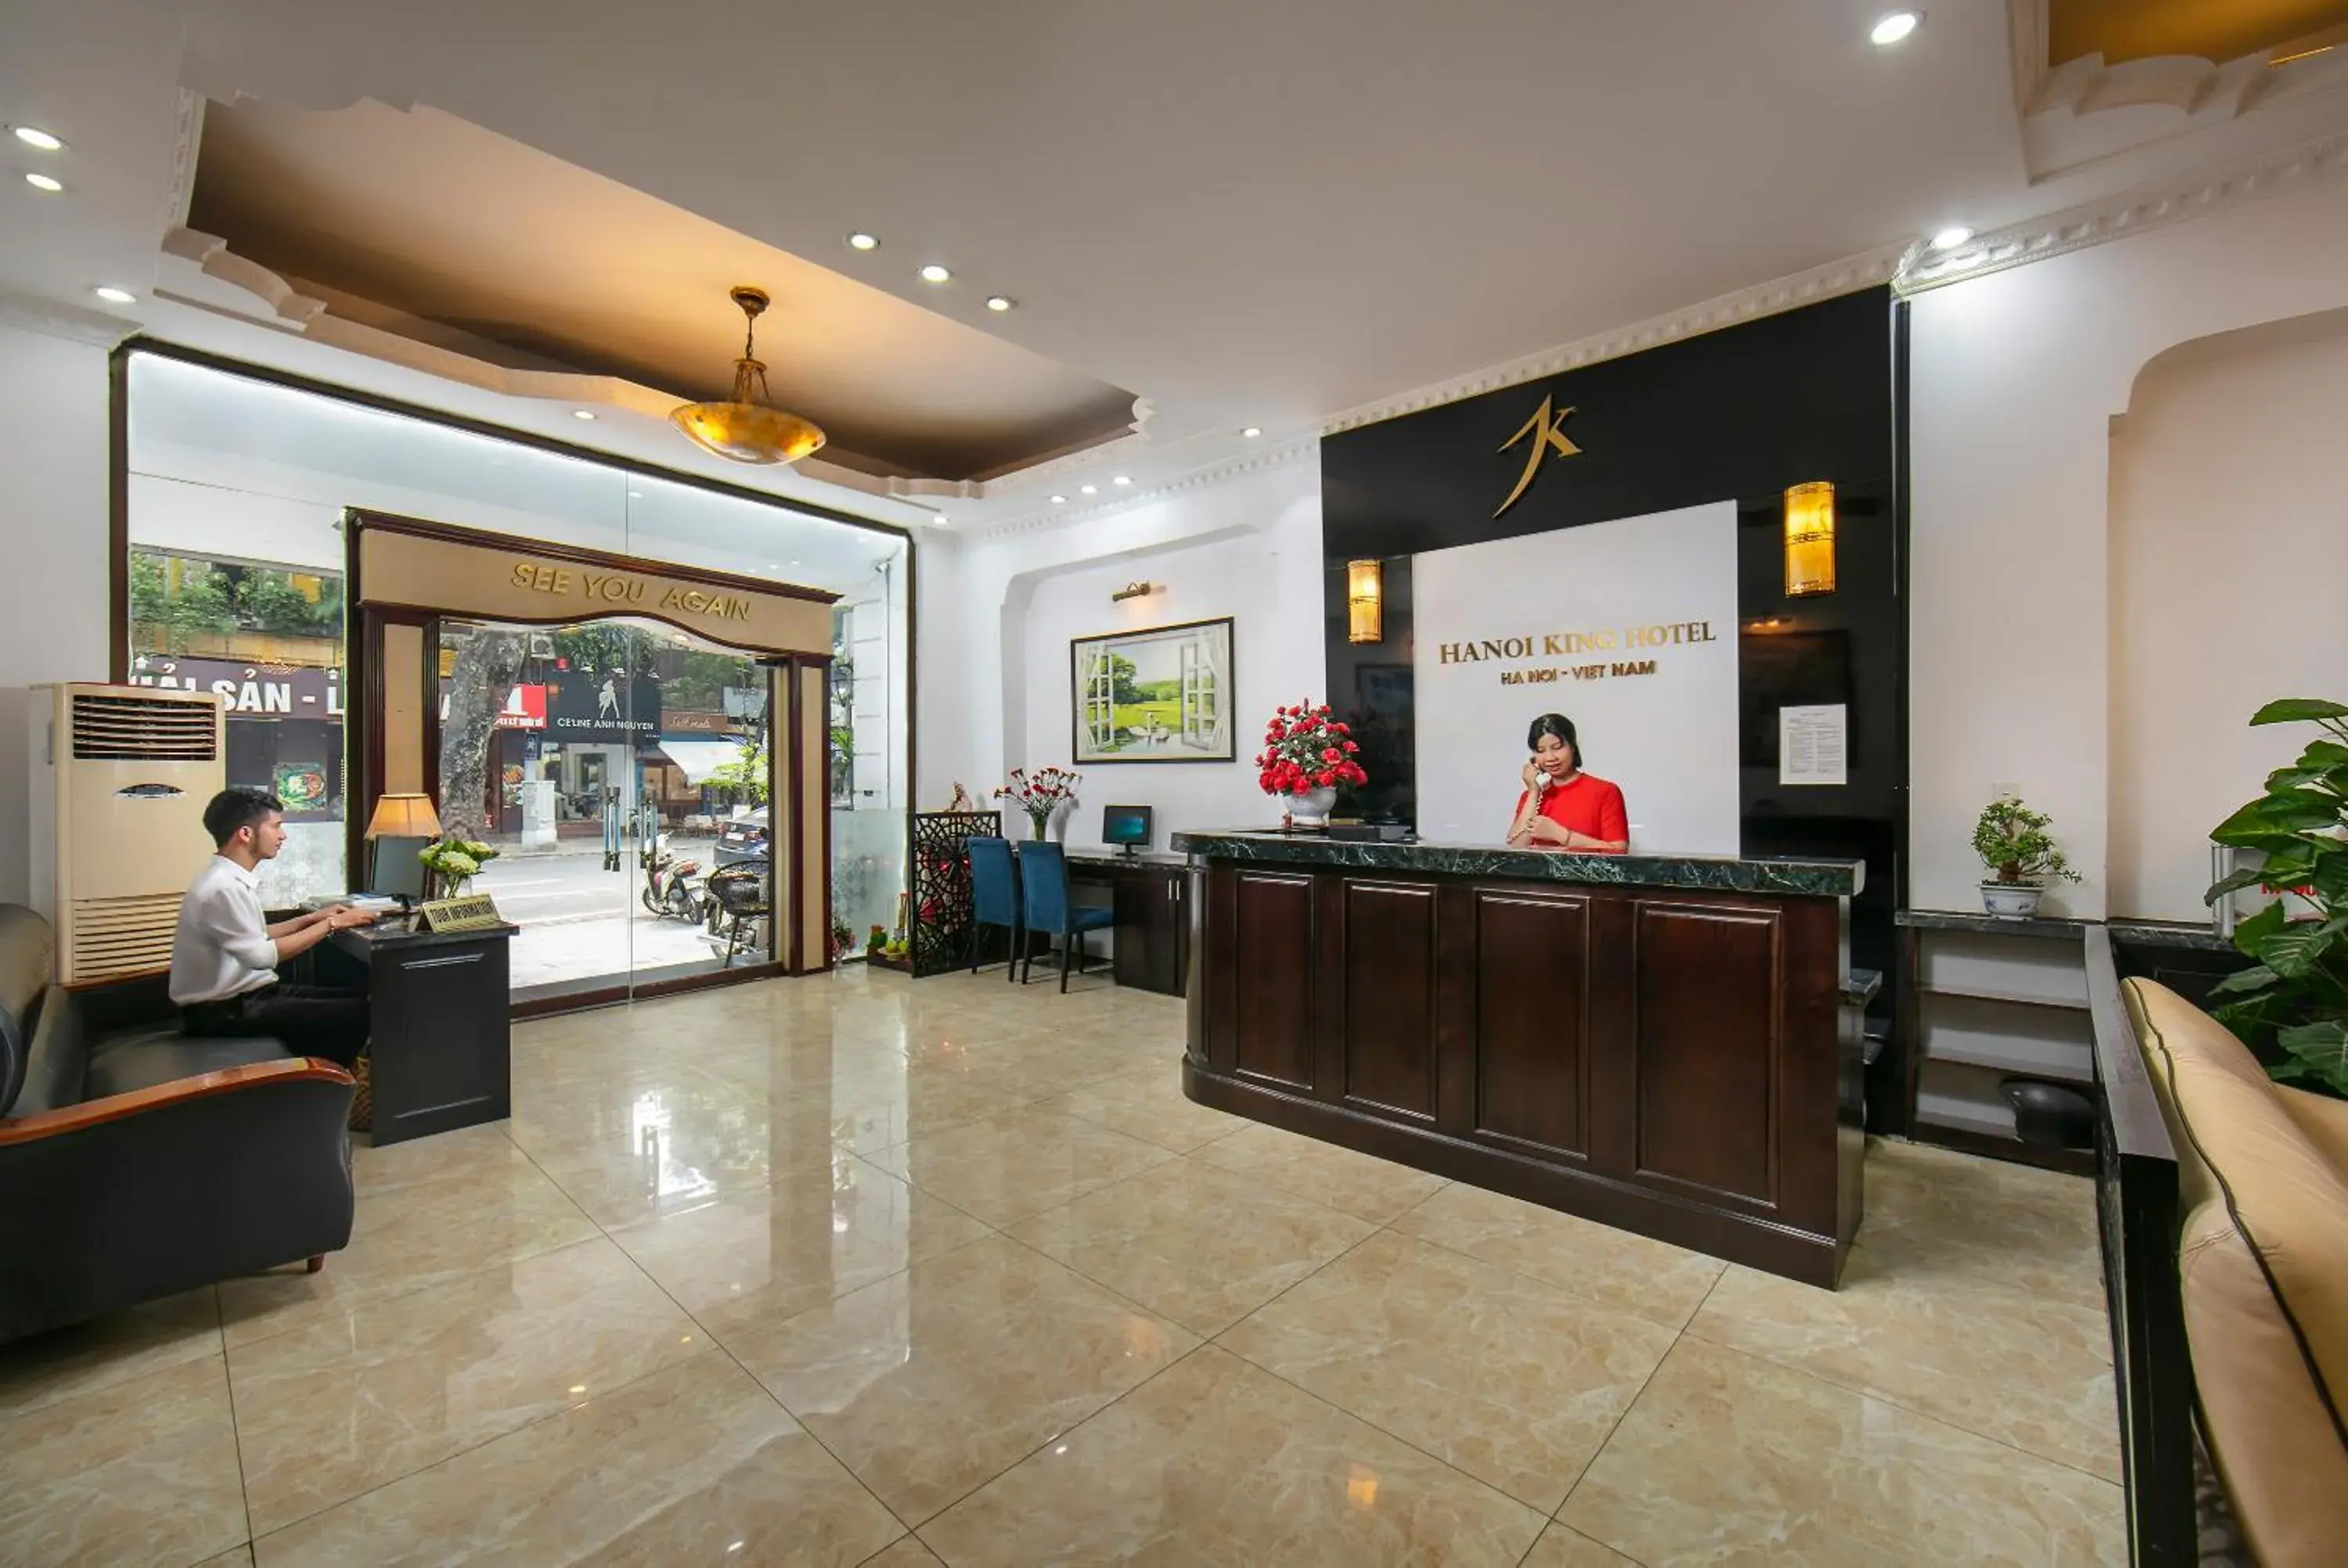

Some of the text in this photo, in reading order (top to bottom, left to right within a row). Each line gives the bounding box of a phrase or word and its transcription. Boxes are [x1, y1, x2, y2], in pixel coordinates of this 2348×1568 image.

[511, 563, 751, 620] SEE YOU AGAIN
[1439, 621, 1716, 664] HANOI KING HOTEL
[1500, 671, 1524, 685] HA
[1527, 668, 1557, 683] NOI
[1572, 664, 1606, 680] VIET
[1612, 660, 1657, 677] NAM
